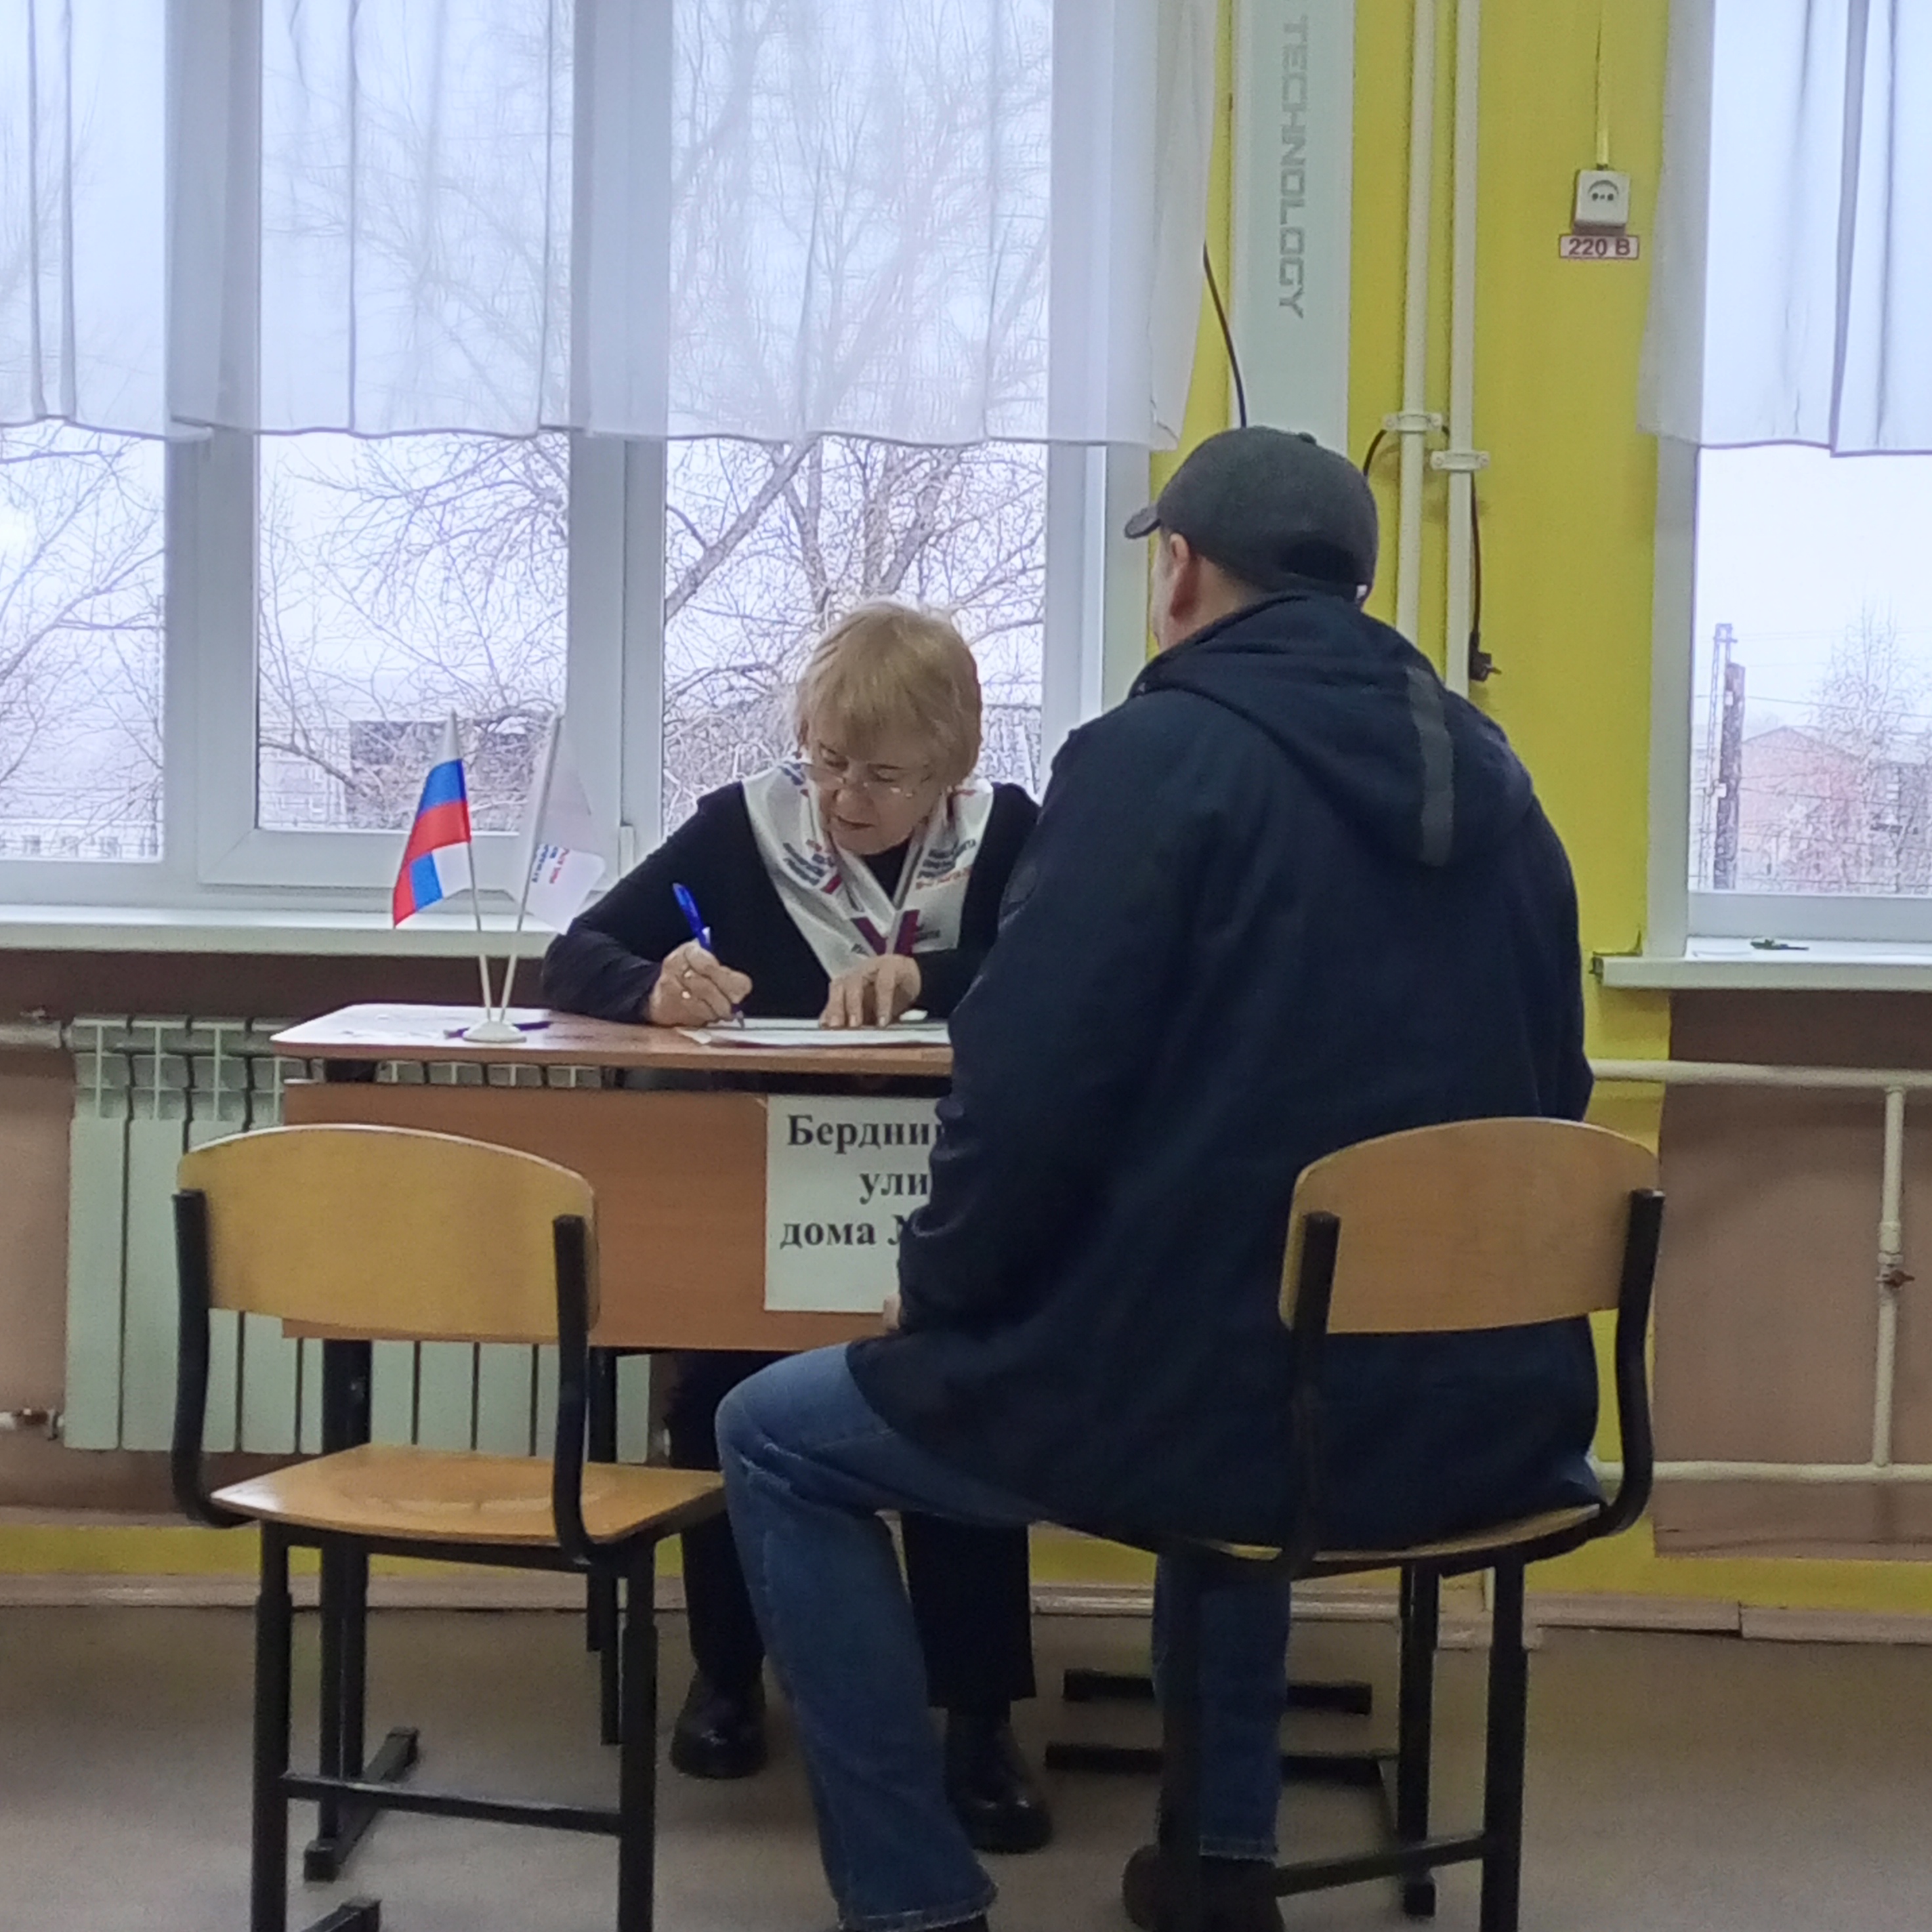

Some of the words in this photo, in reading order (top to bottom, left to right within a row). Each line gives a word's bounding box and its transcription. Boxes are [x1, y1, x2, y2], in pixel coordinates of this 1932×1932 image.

[1278, 13, 1309, 320] TECHNOLOGY
[1568, 238, 1607, 258] 220
[1615, 238, 1631, 256] В
[859, 1173, 929, 1205] ули
[780, 1221, 876, 1250] дома
